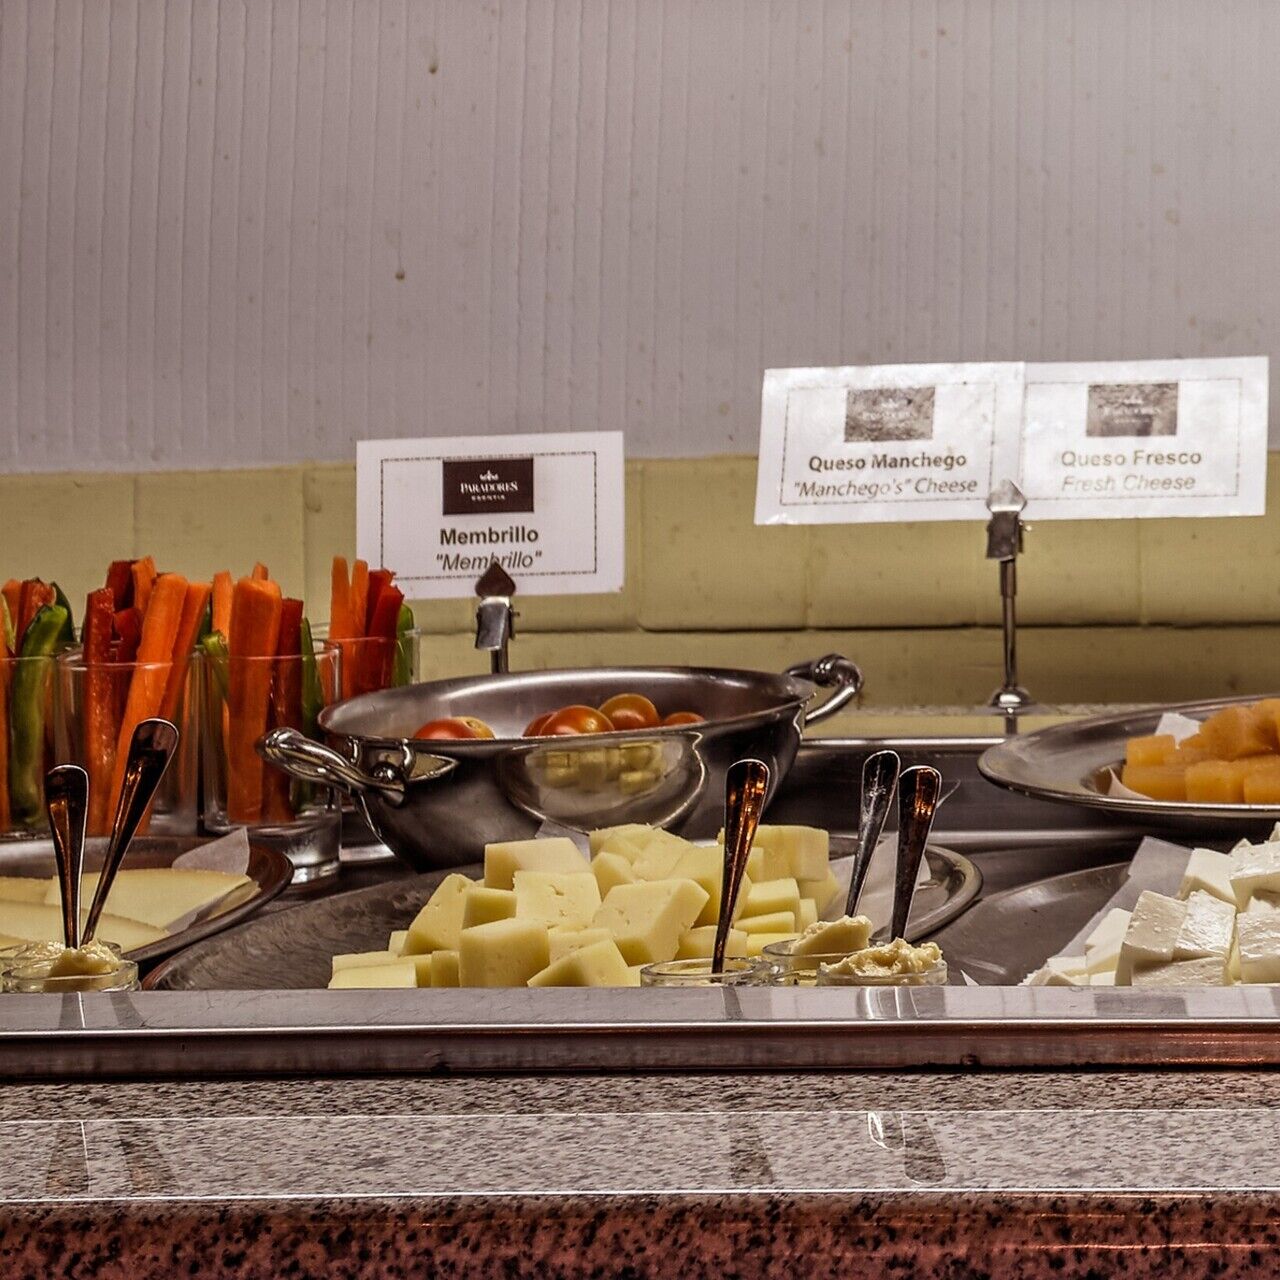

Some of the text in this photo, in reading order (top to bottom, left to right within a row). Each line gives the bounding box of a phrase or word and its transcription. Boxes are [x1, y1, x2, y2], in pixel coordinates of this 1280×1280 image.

[808, 451, 967, 474] Queso Manchego
[1061, 449, 1203, 468] Queso Fresco
[794, 476, 978, 499] "Manchego's" Cheese
[1061, 473, 1197, 492] Fresh Cheese
[440, 525, 539, 546] Membrillo
[435, 549, 543, 571] "Membrillo"
